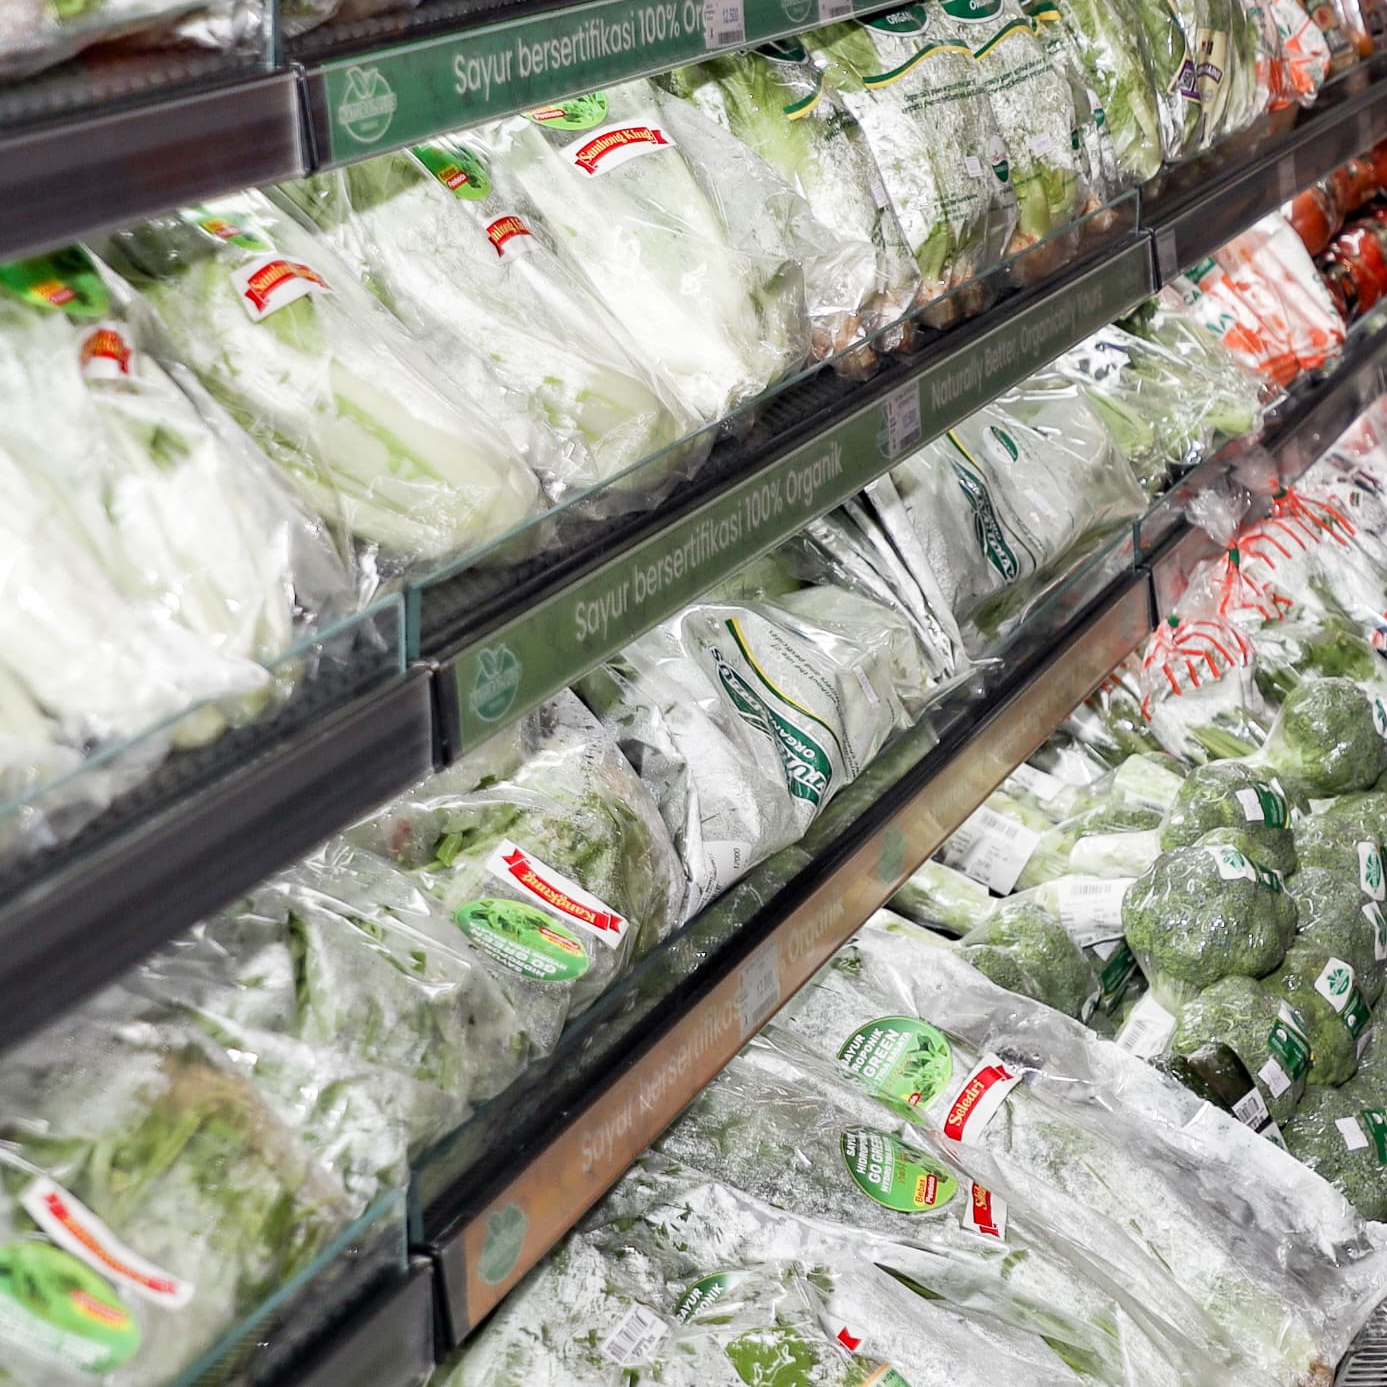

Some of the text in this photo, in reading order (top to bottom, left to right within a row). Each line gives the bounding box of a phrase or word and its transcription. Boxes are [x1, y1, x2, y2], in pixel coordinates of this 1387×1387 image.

[453, 49, 514, 102] Sayur
[517, 16, 637, 77] bersertifikasi
[638, 2, 681, 44] 100%
[931, 361, 985, 412] Naturally
[575, 438, 844, 643] Sayur bersertifikasi 100% Organik
[523, 869, 598, 924] Kangkung
[468, 926, 558, 975] GO GREEN
[851, 1027, 884, 1073] ROPONIK
[862, 1028, 900, 1078] GREEN
[948, 1078, 985, 1127] Seledri
[868, 1163, 882, 1184] GO
